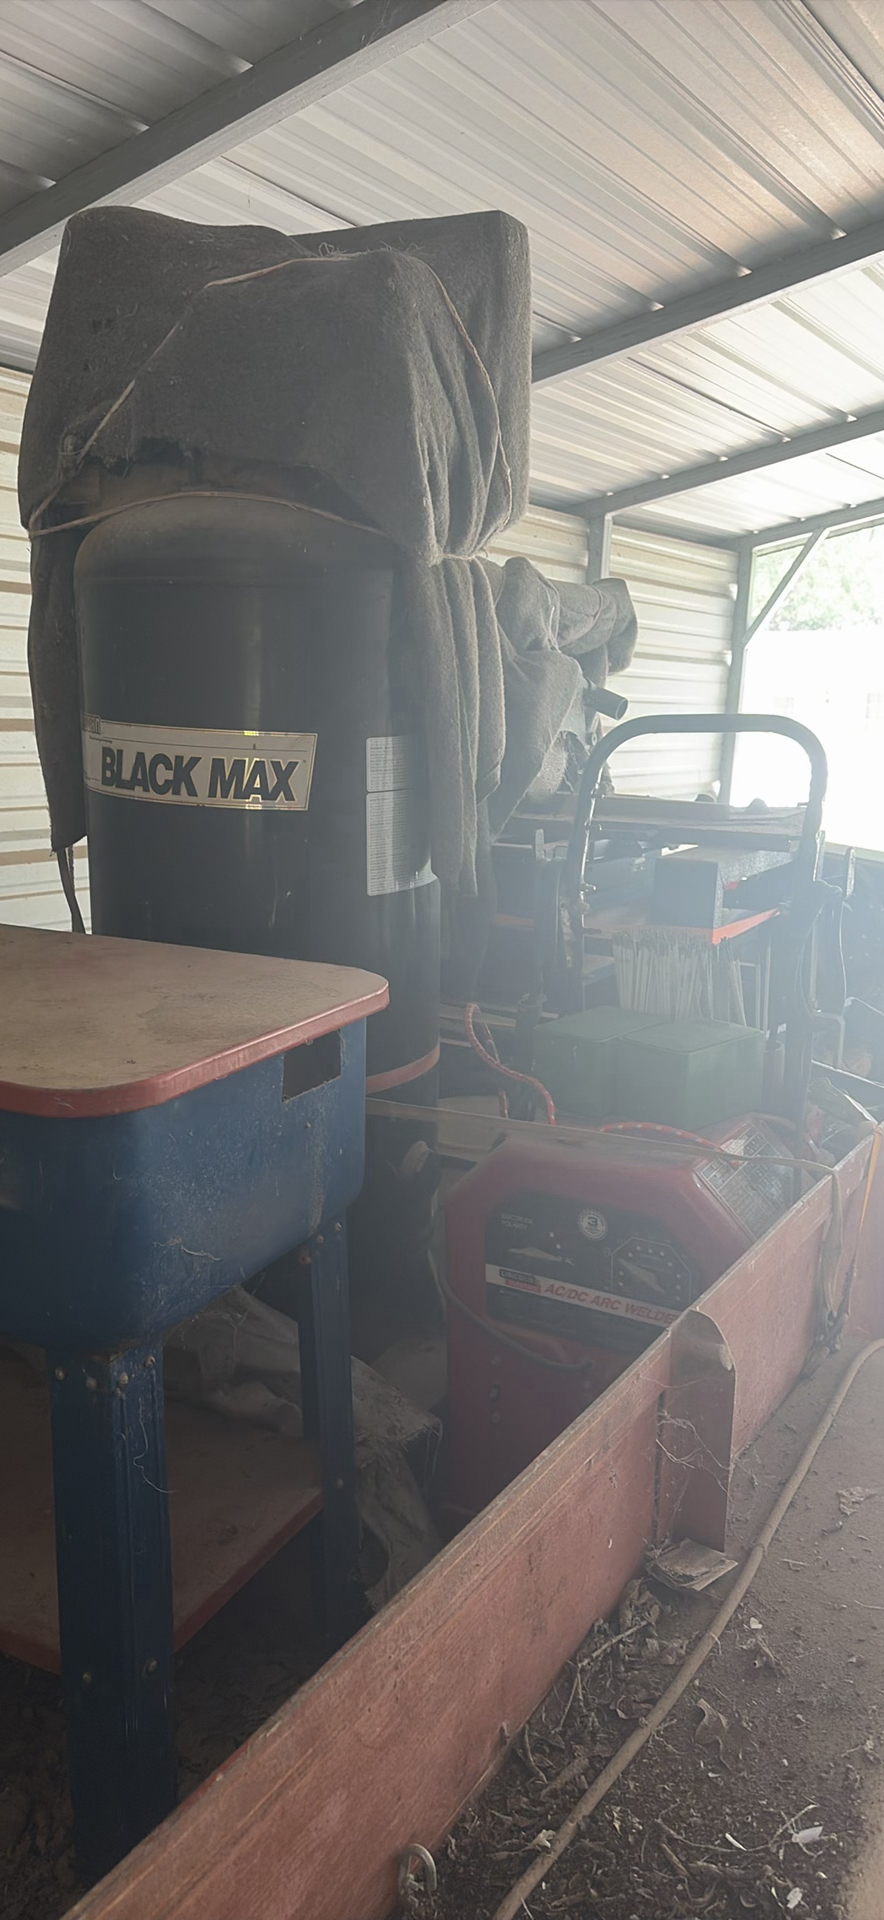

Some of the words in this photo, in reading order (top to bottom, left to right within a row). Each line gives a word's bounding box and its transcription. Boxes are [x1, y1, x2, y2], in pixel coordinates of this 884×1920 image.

[101, 746, 203, 798] BLACK
[208, 757, 301, 803] MAX
[587, 1216, 599, 1227] 3
[544, 1284, 589, 1302] AC/DC
[589, 1295, 622, 1310] ARC
